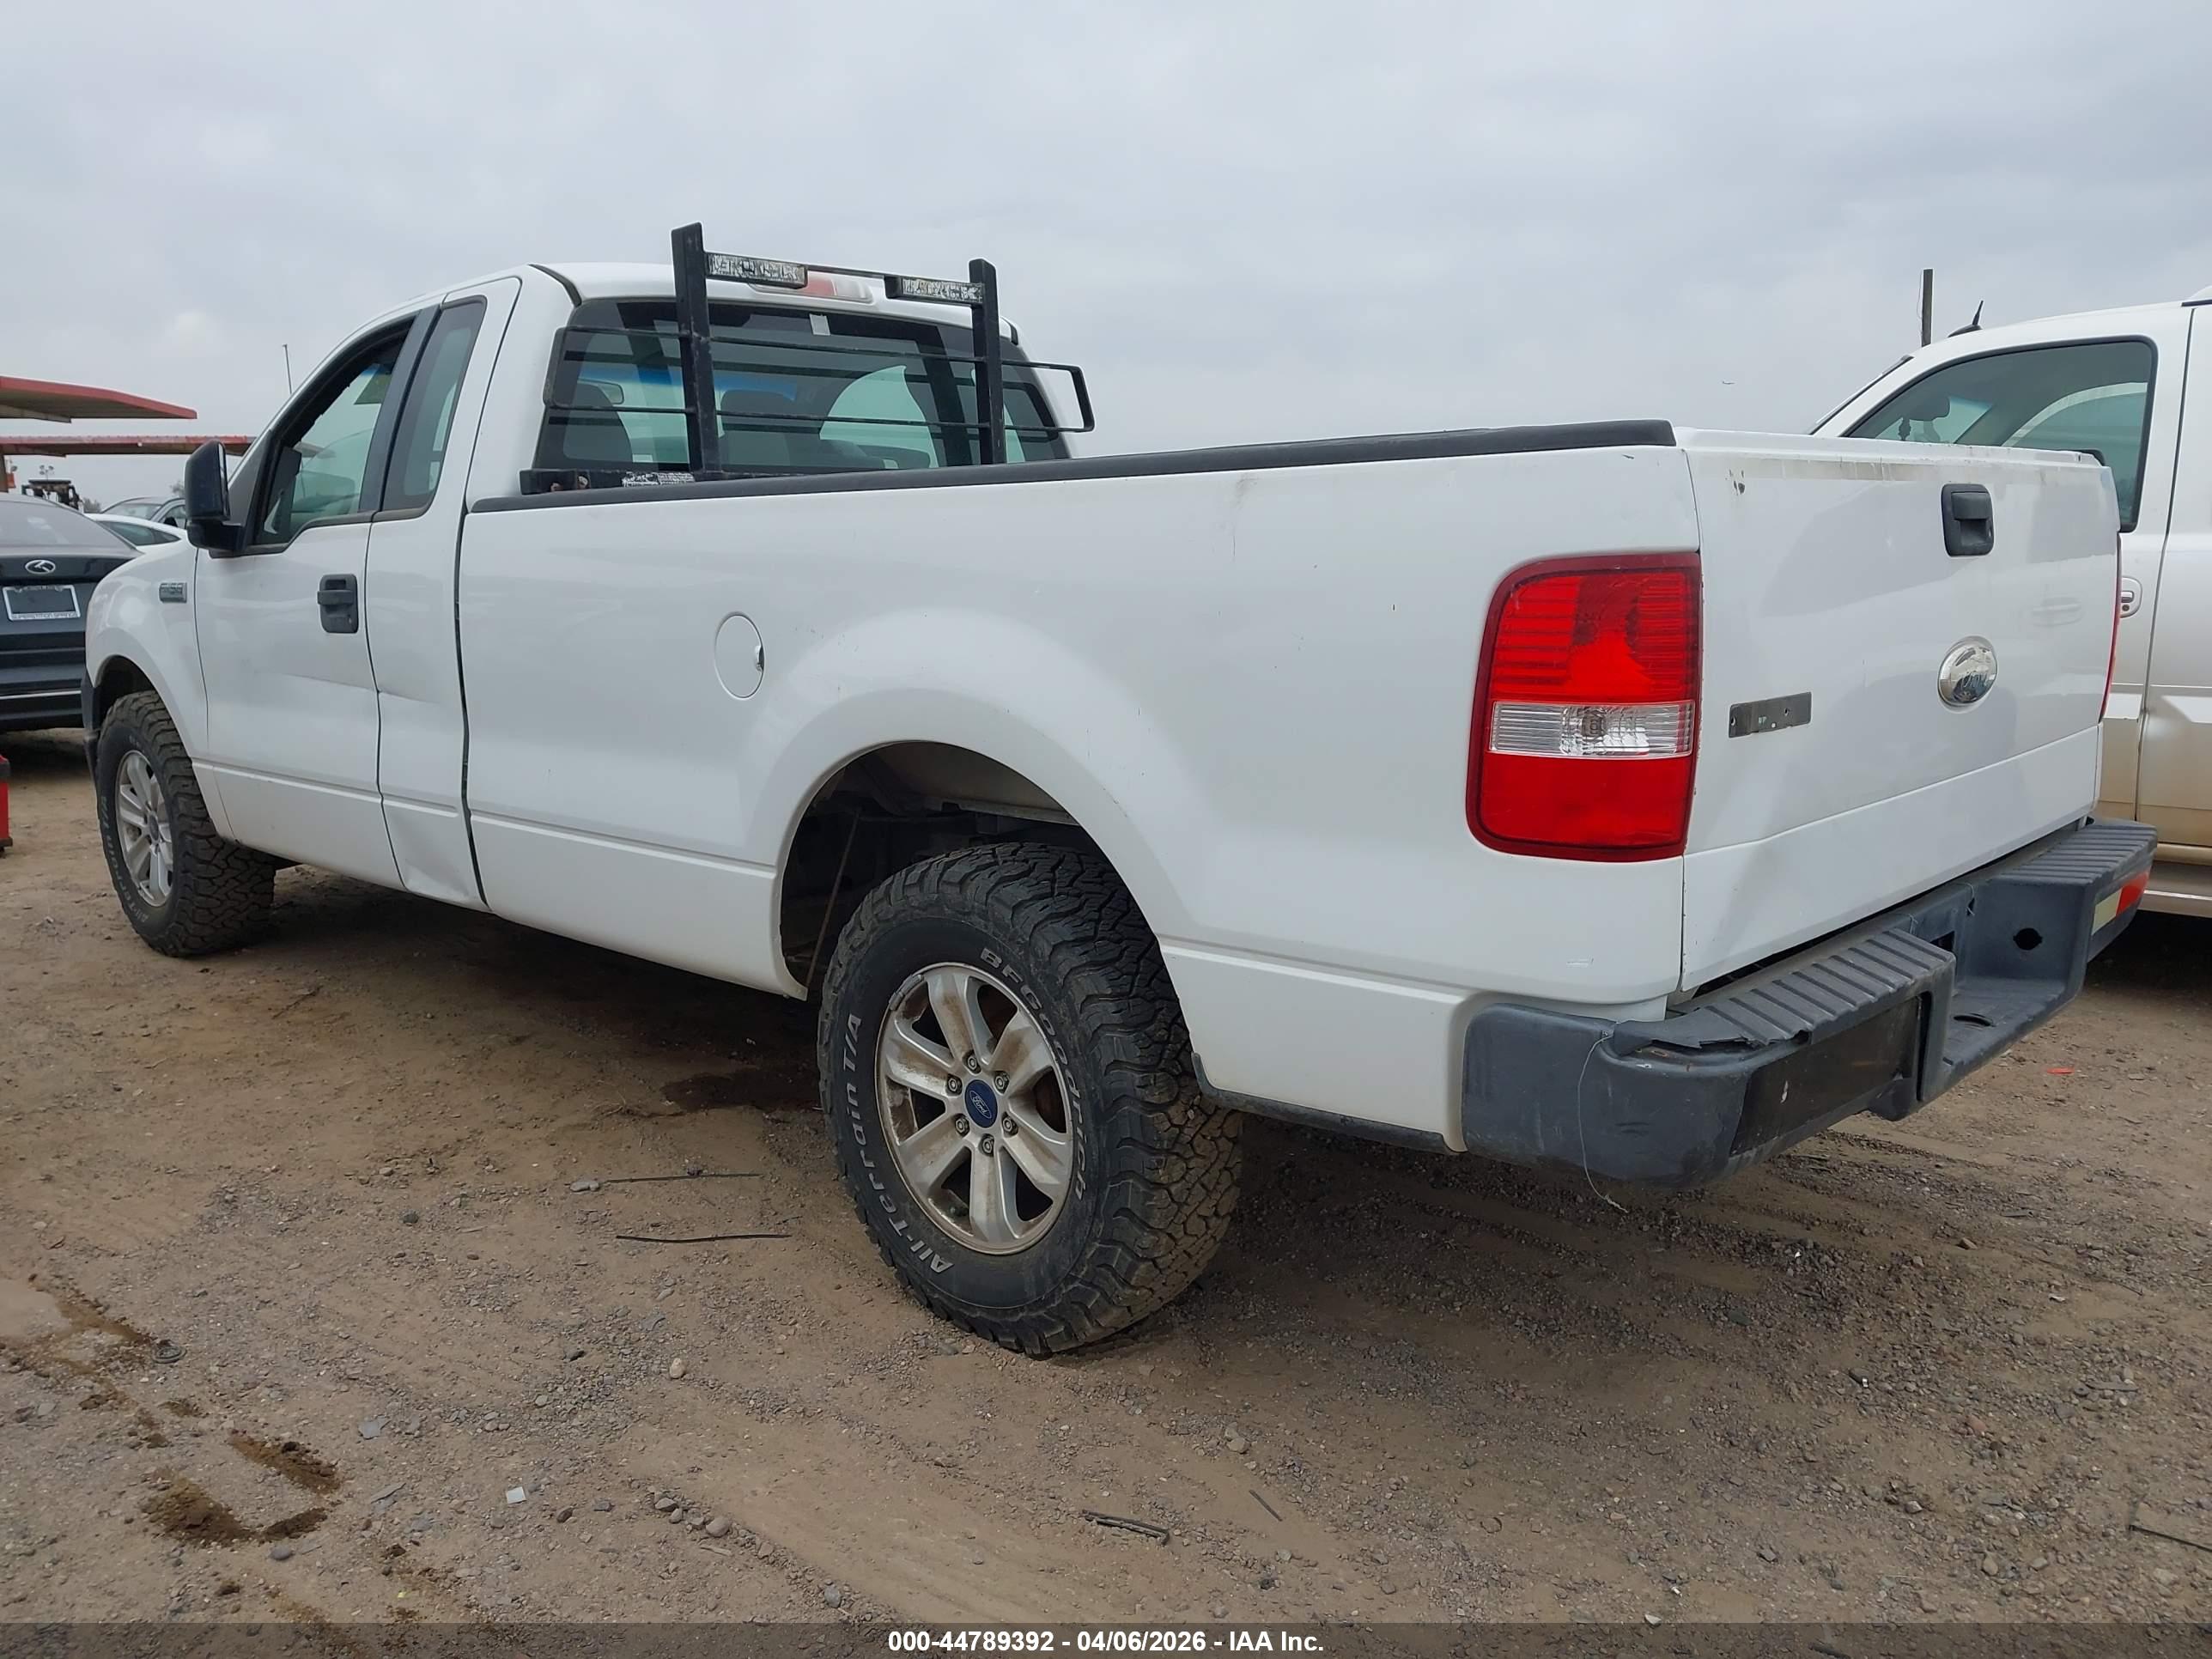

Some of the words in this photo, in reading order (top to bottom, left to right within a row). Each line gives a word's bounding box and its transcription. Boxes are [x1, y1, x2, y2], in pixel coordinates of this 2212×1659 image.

[843, 1013, 862, 1072] T/A
[970, 1093, 990, 1116] Ford
[846, 1082, 954, 1273] All-Terrain
